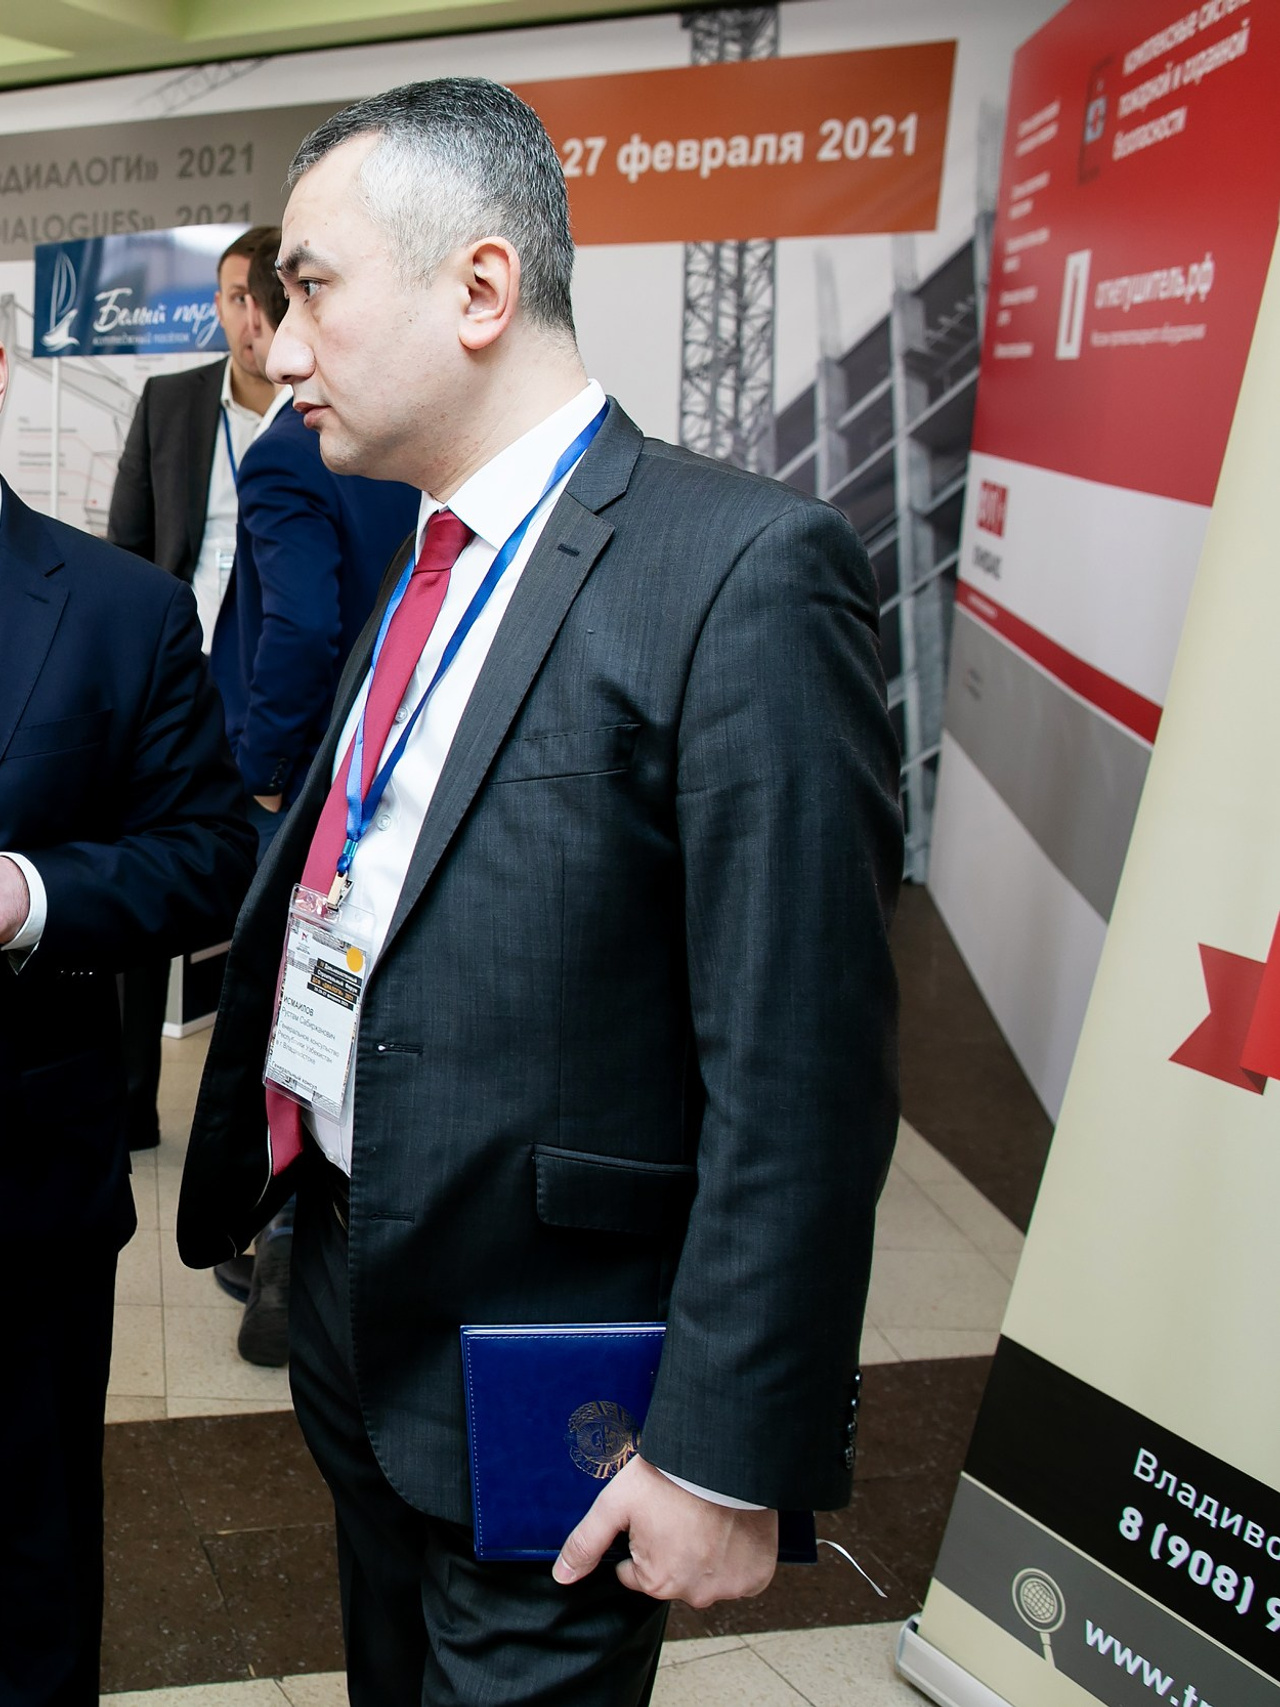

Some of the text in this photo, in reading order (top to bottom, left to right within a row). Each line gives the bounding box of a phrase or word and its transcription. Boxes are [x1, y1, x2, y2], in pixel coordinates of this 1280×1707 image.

[177, 142, 254, 180] 2021
[562, 113, 919, 182] 27 февраля 2021
[172, 302, 220, 349] пару
[283, 995, 314, 1016] ИСМАИЛОВ
[1119, 1506, 1144, 1542] 8
[1150, 1522, 1255, 1615] (908)
[1085, 1619, 1214, 1707] www.t
